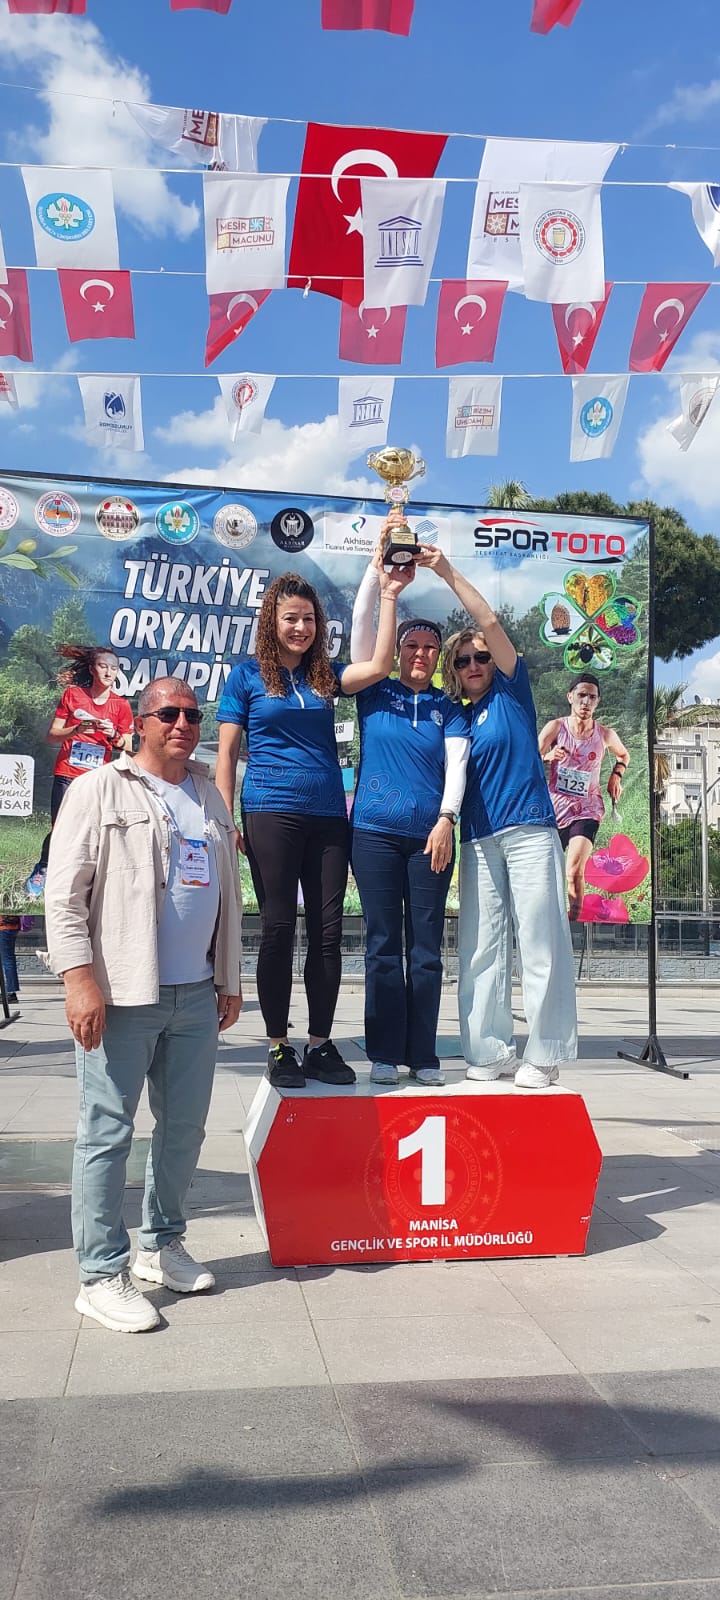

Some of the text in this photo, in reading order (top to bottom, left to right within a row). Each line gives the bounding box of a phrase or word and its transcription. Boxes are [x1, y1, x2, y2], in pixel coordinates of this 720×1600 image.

[220, 220, 247, 232] MESİR
[232, 234, 272, 245] MACUNU
[344, 536, 374, 546] Akhisar
[124, 553, 270, 608] TÜRKİYE
[564, 778, 585, 792] 123
[398, 1115, 446, 1205] 1
[409, 1217, 458, 1231] MANİSA
[331, 1231, 533, 1253] GENÇLİK VE SPOR İL MÜDÜRLÜĞÜ
